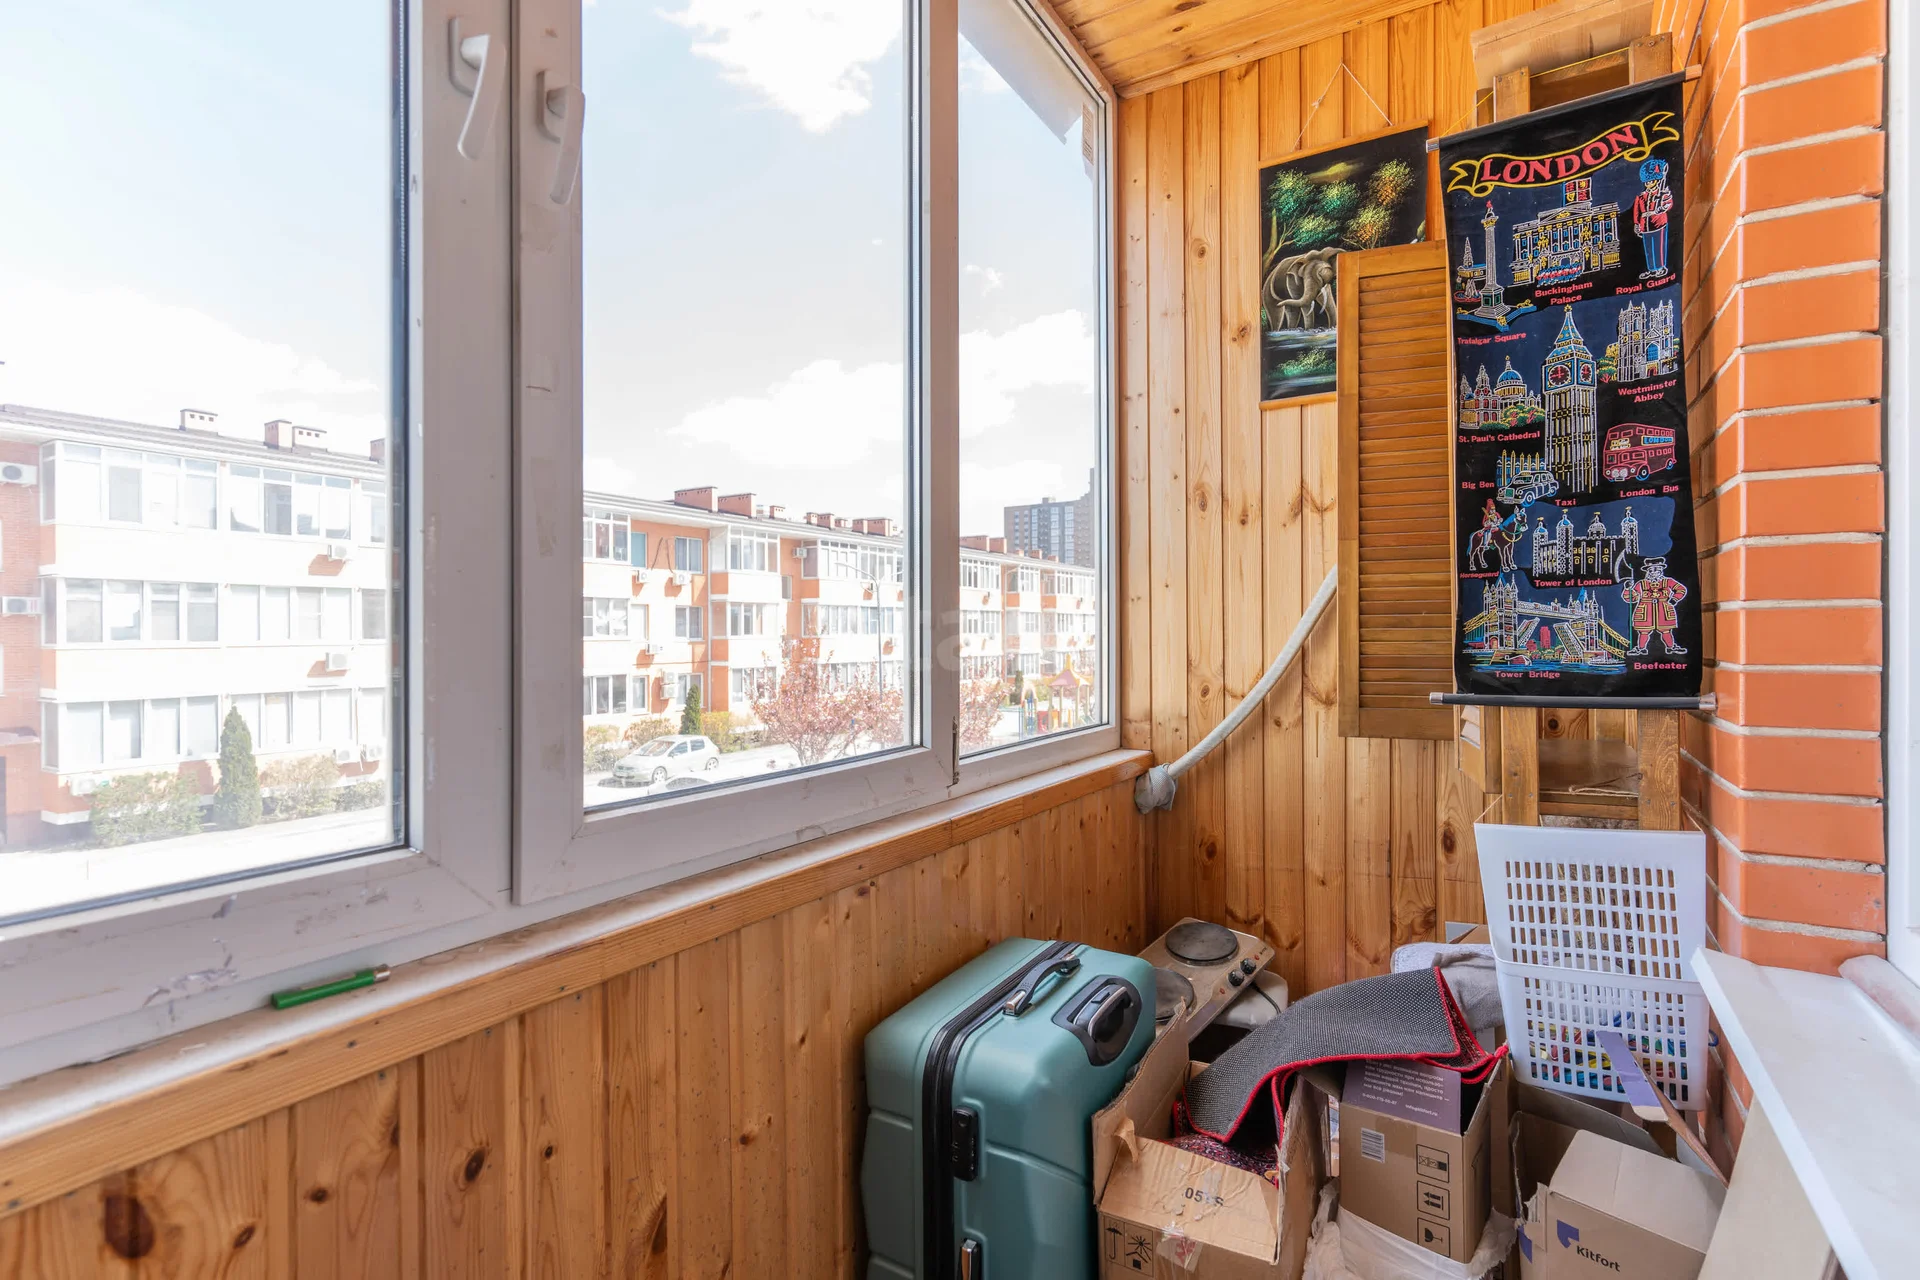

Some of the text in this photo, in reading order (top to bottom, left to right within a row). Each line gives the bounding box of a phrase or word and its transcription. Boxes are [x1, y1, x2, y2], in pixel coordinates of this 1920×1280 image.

[1480, 125, 1639, 183] LONDON
[1534, 281, 1593, 298] Buckingham
[1615, 273, 1676, 295] Royal Guard
[1550, 295, 1582, 306] Palace
[1457, 332, 1527, 345] Trafalgar Square
[1617, 379, 1677, 396] Westminster
[1633, 391, 1664, 403] Abbey
[1458, 430, 1541, 443] St. Paul's Cathedral
[1461, 480, 1495, 490] Big Ben
[1620, 484, 1679, 498] London Bus
[1554, 498, 1576, 507] Taxi
[1534, 578, 1612, 588] Tower of London
[1633, 661, 1688, 671] Beefeater
[1495, 670, 1561, 680] Tower Bridge
[1576, 1245, 1620, 1272] Kitfort
